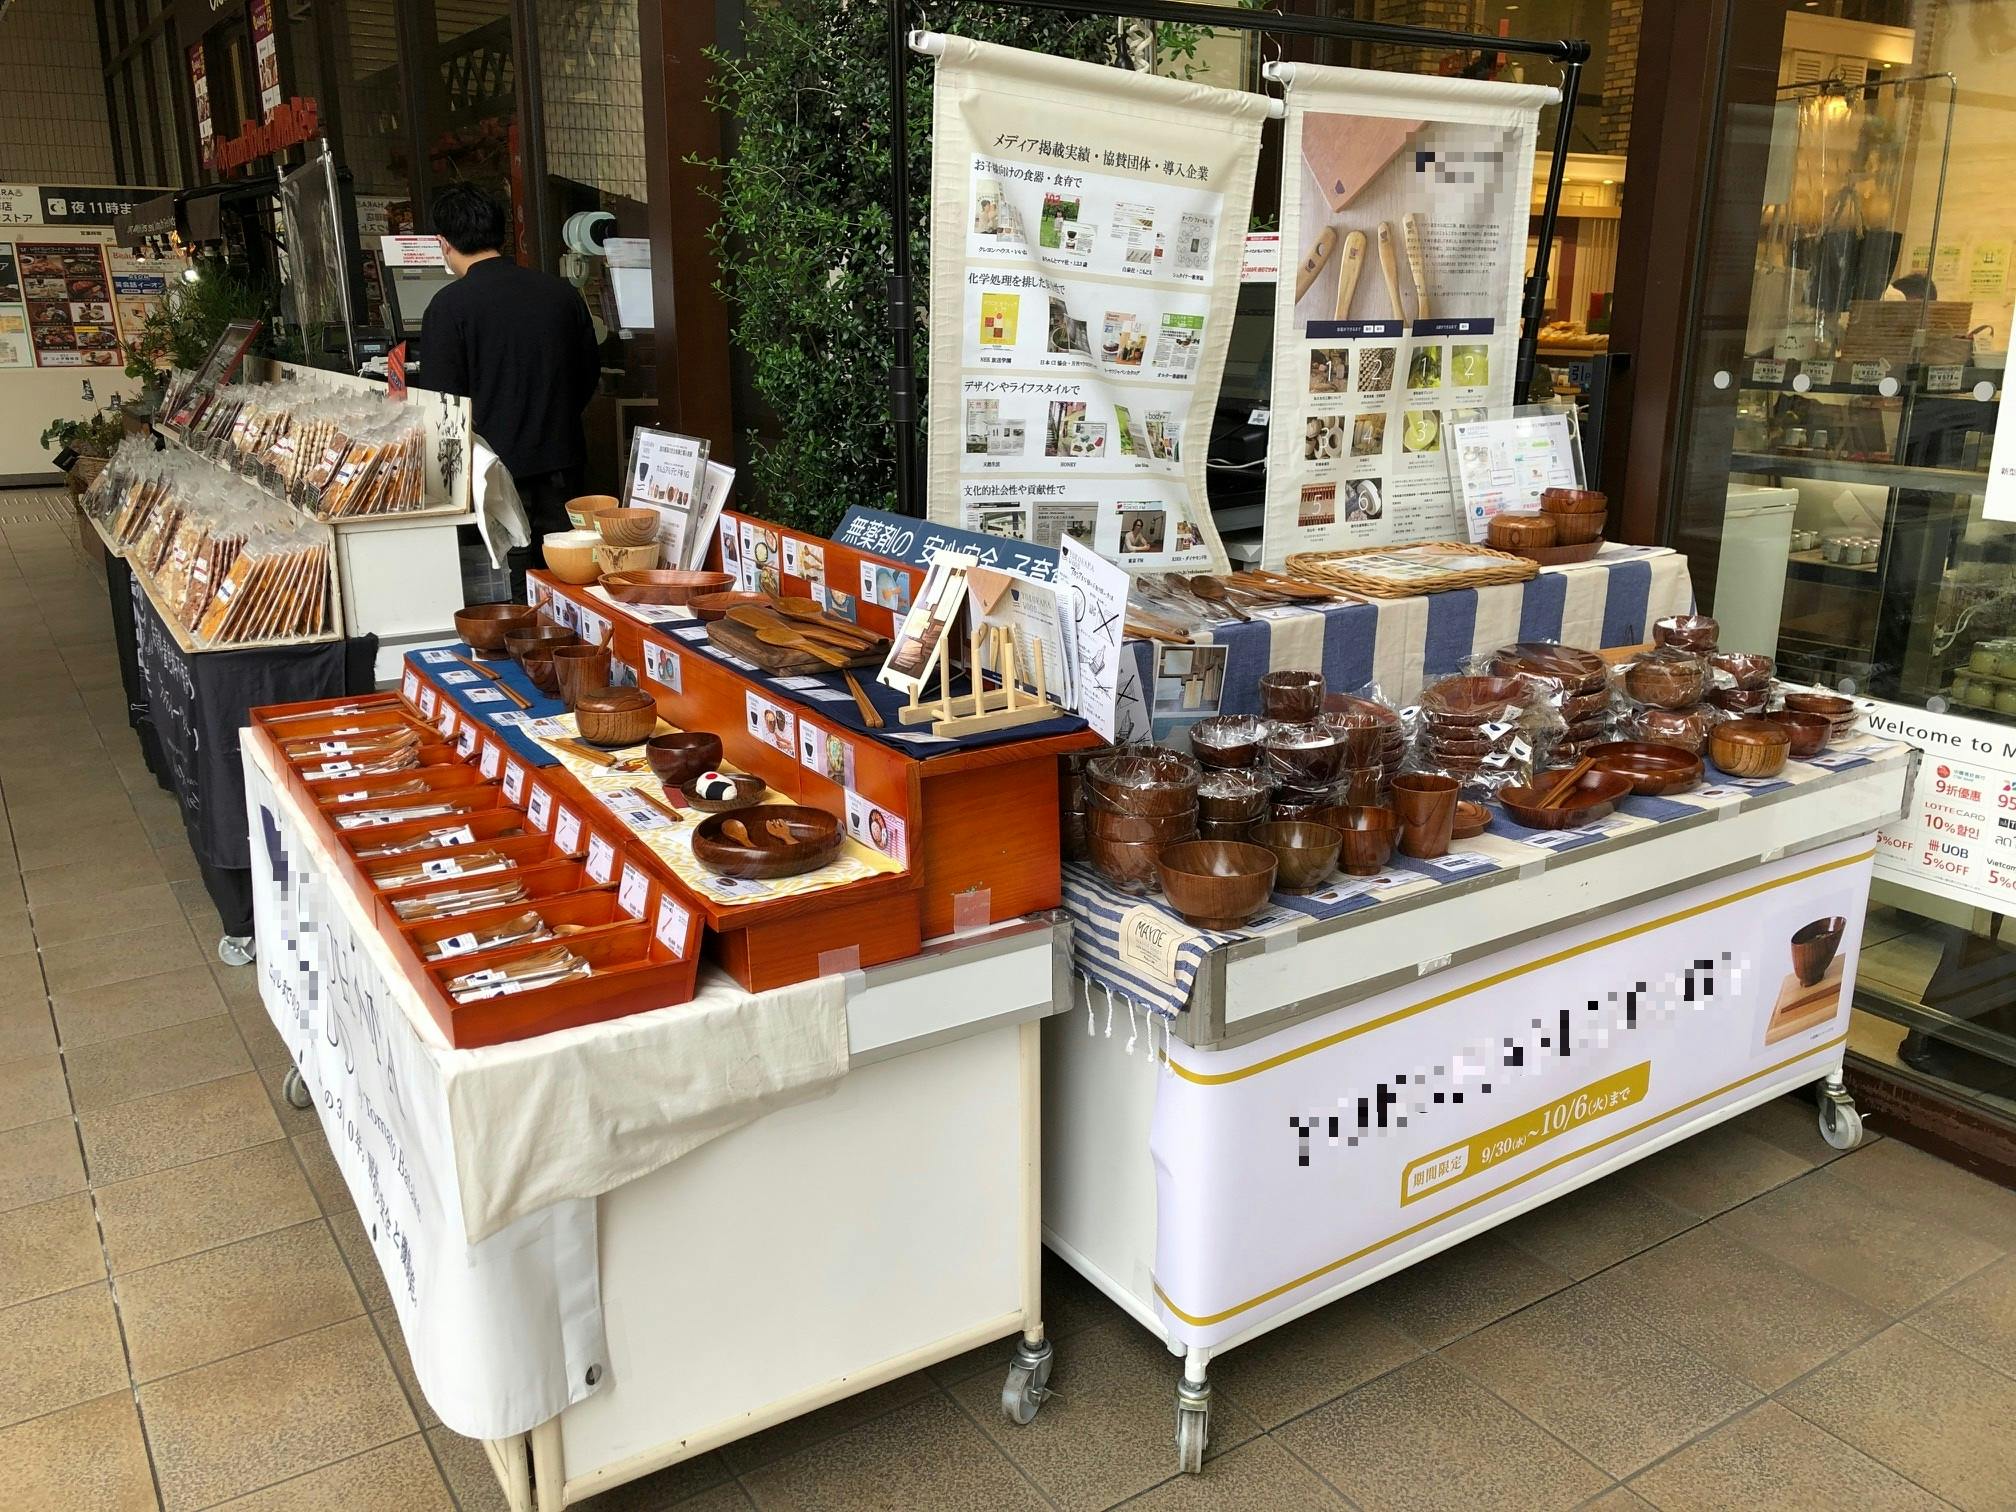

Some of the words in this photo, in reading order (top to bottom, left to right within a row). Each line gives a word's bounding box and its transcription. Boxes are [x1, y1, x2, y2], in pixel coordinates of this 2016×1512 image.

[993, 132, 1209, 182] メディア掲載実績・協賛団体・導入企業
[974, 158, 1083, 189] お子様向けの食器・食育で
[71, 201, 140, 215] 夜11時ま
[1325, 360, 1332, 382] 1
[1371, 359, 1383, 380] 2
[1421, 356, 1427, 377] 1
[1464, 355, 1474, 377] 2
[964, 380, 1081, 396] デザインやライフスタイルで
[1416, 421, 1427, 442] 3
[963, 484, 1067, 496] 文化的社会性や貢献性で
[1358, 489, 1369, 511] 6
[841, 515, 915, 557] 無薬剤の
[1868, 714, 1962, 746] Welcome
[1972, 737, 1993, 754] to
[1941, 842, 1970, 859] UOB
[1922, 852, 1971, 876] 5%OFF
[1413, 1154, 1462, 1187] 期間限定
